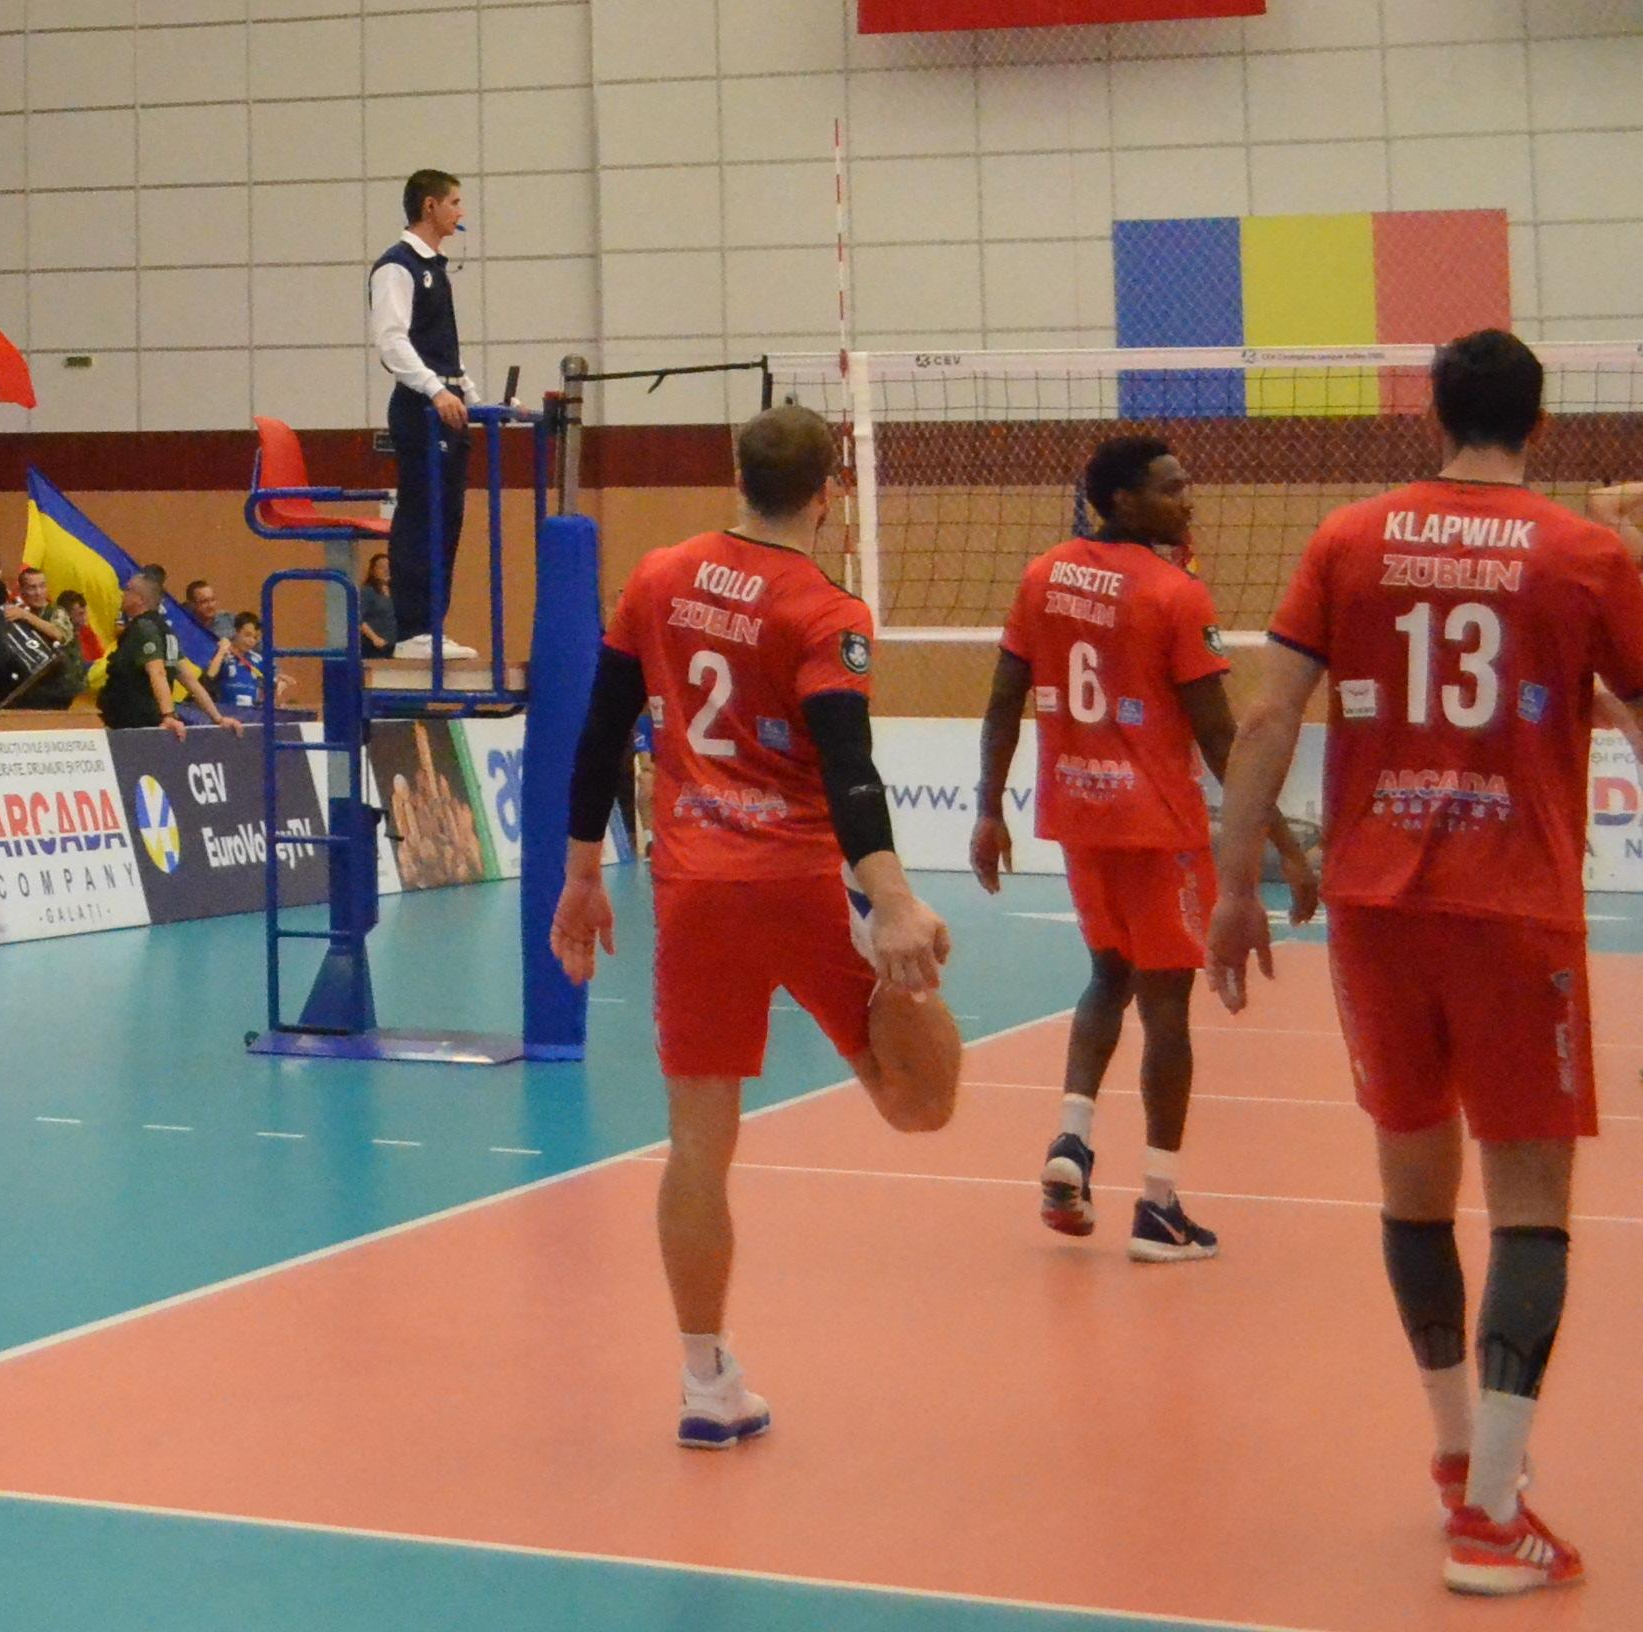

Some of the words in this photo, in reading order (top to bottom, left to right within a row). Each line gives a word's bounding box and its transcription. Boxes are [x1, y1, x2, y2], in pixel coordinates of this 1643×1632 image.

[934, 356, 961, 365] CEV
[1383, 511, 1536, 549] KLAPWIJK
[694, 560, 764, 603] KOLLO
[1049, 560, 1124, 596] BISSETTE
[1068, 640, 1106, 724] 6
[1395, 601, 1502, 729] 13
[686, 650, 737, 757] 2
[188, 762, 227, 805] CEV
[202, 818, 314, 869] EuroVoeyTV
